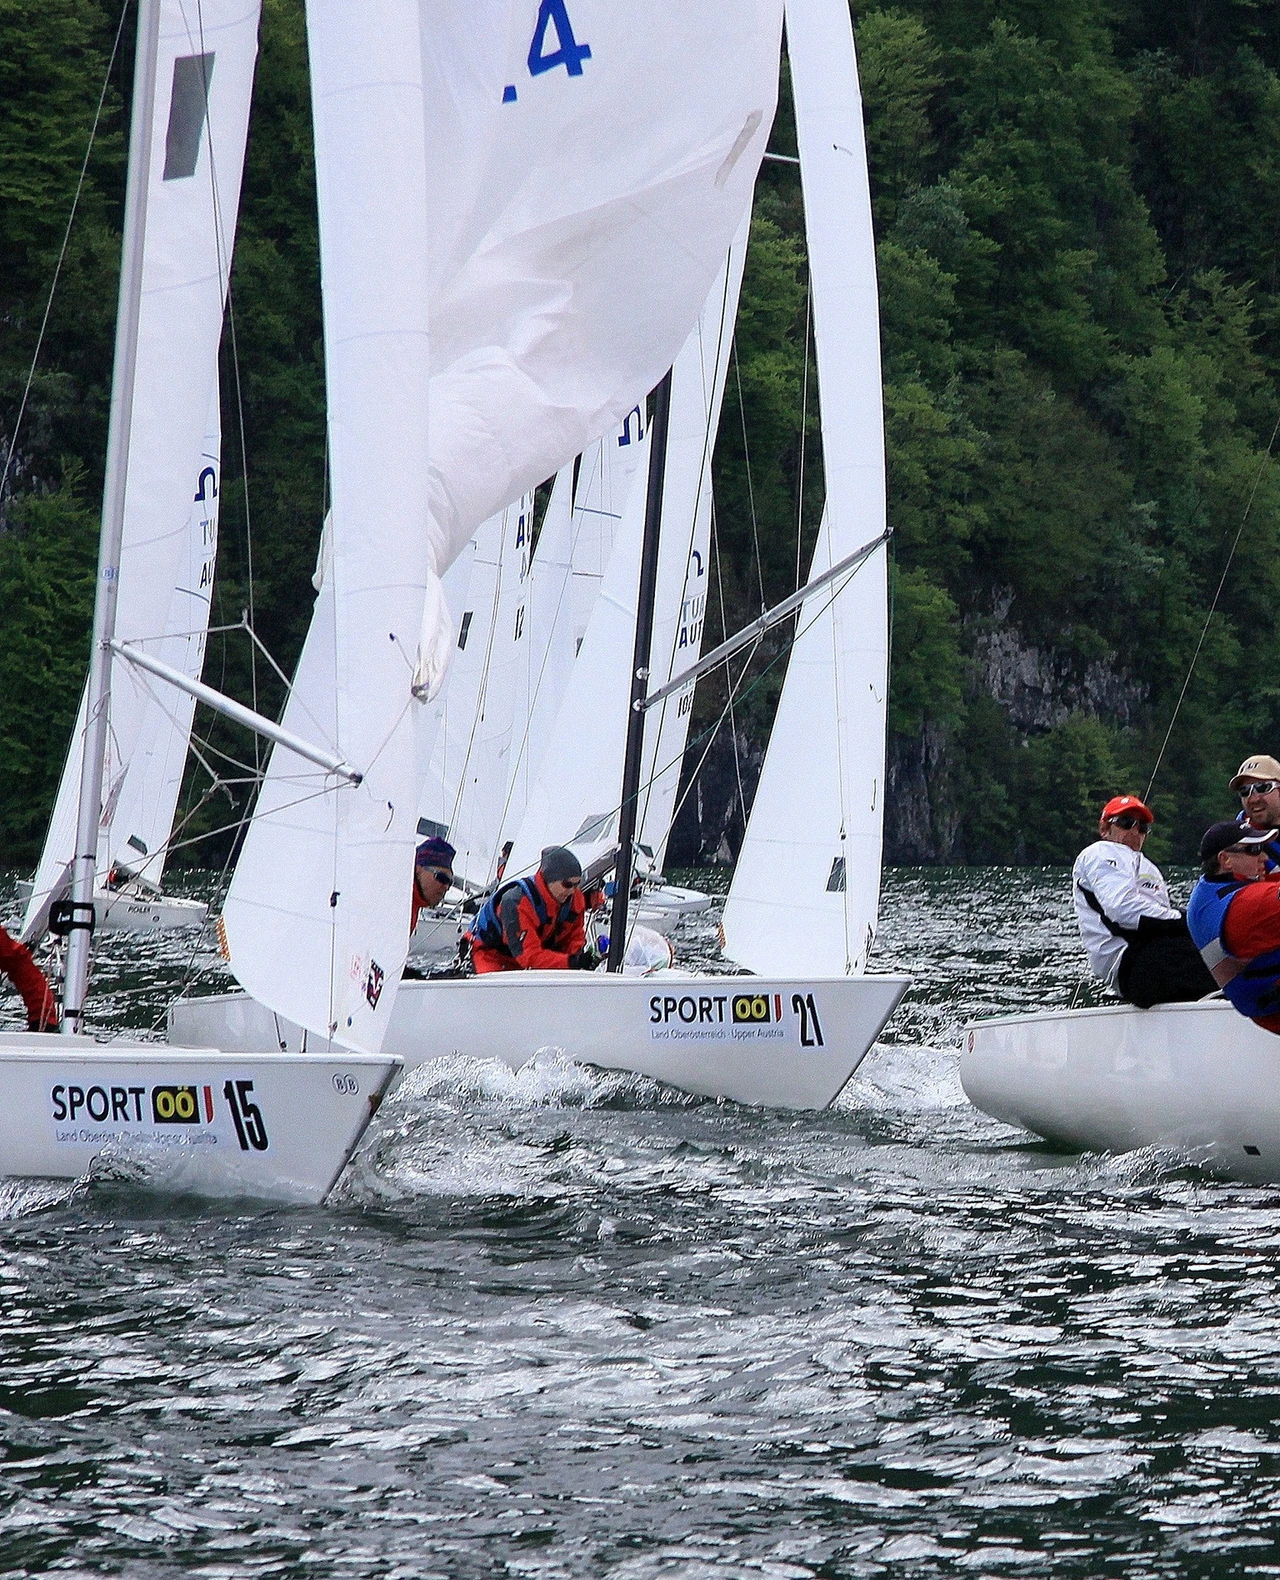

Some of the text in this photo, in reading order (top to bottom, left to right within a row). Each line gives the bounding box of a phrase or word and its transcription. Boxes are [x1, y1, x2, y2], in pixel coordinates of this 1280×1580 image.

[527, 0, 592, 77] 4
[649, 995, 727, 1024] SPORT
[791, 993, 825, 1047] 21
[51, 1085, 146, 1122] SPORT
[222, 1079, 269, 1151] 15
